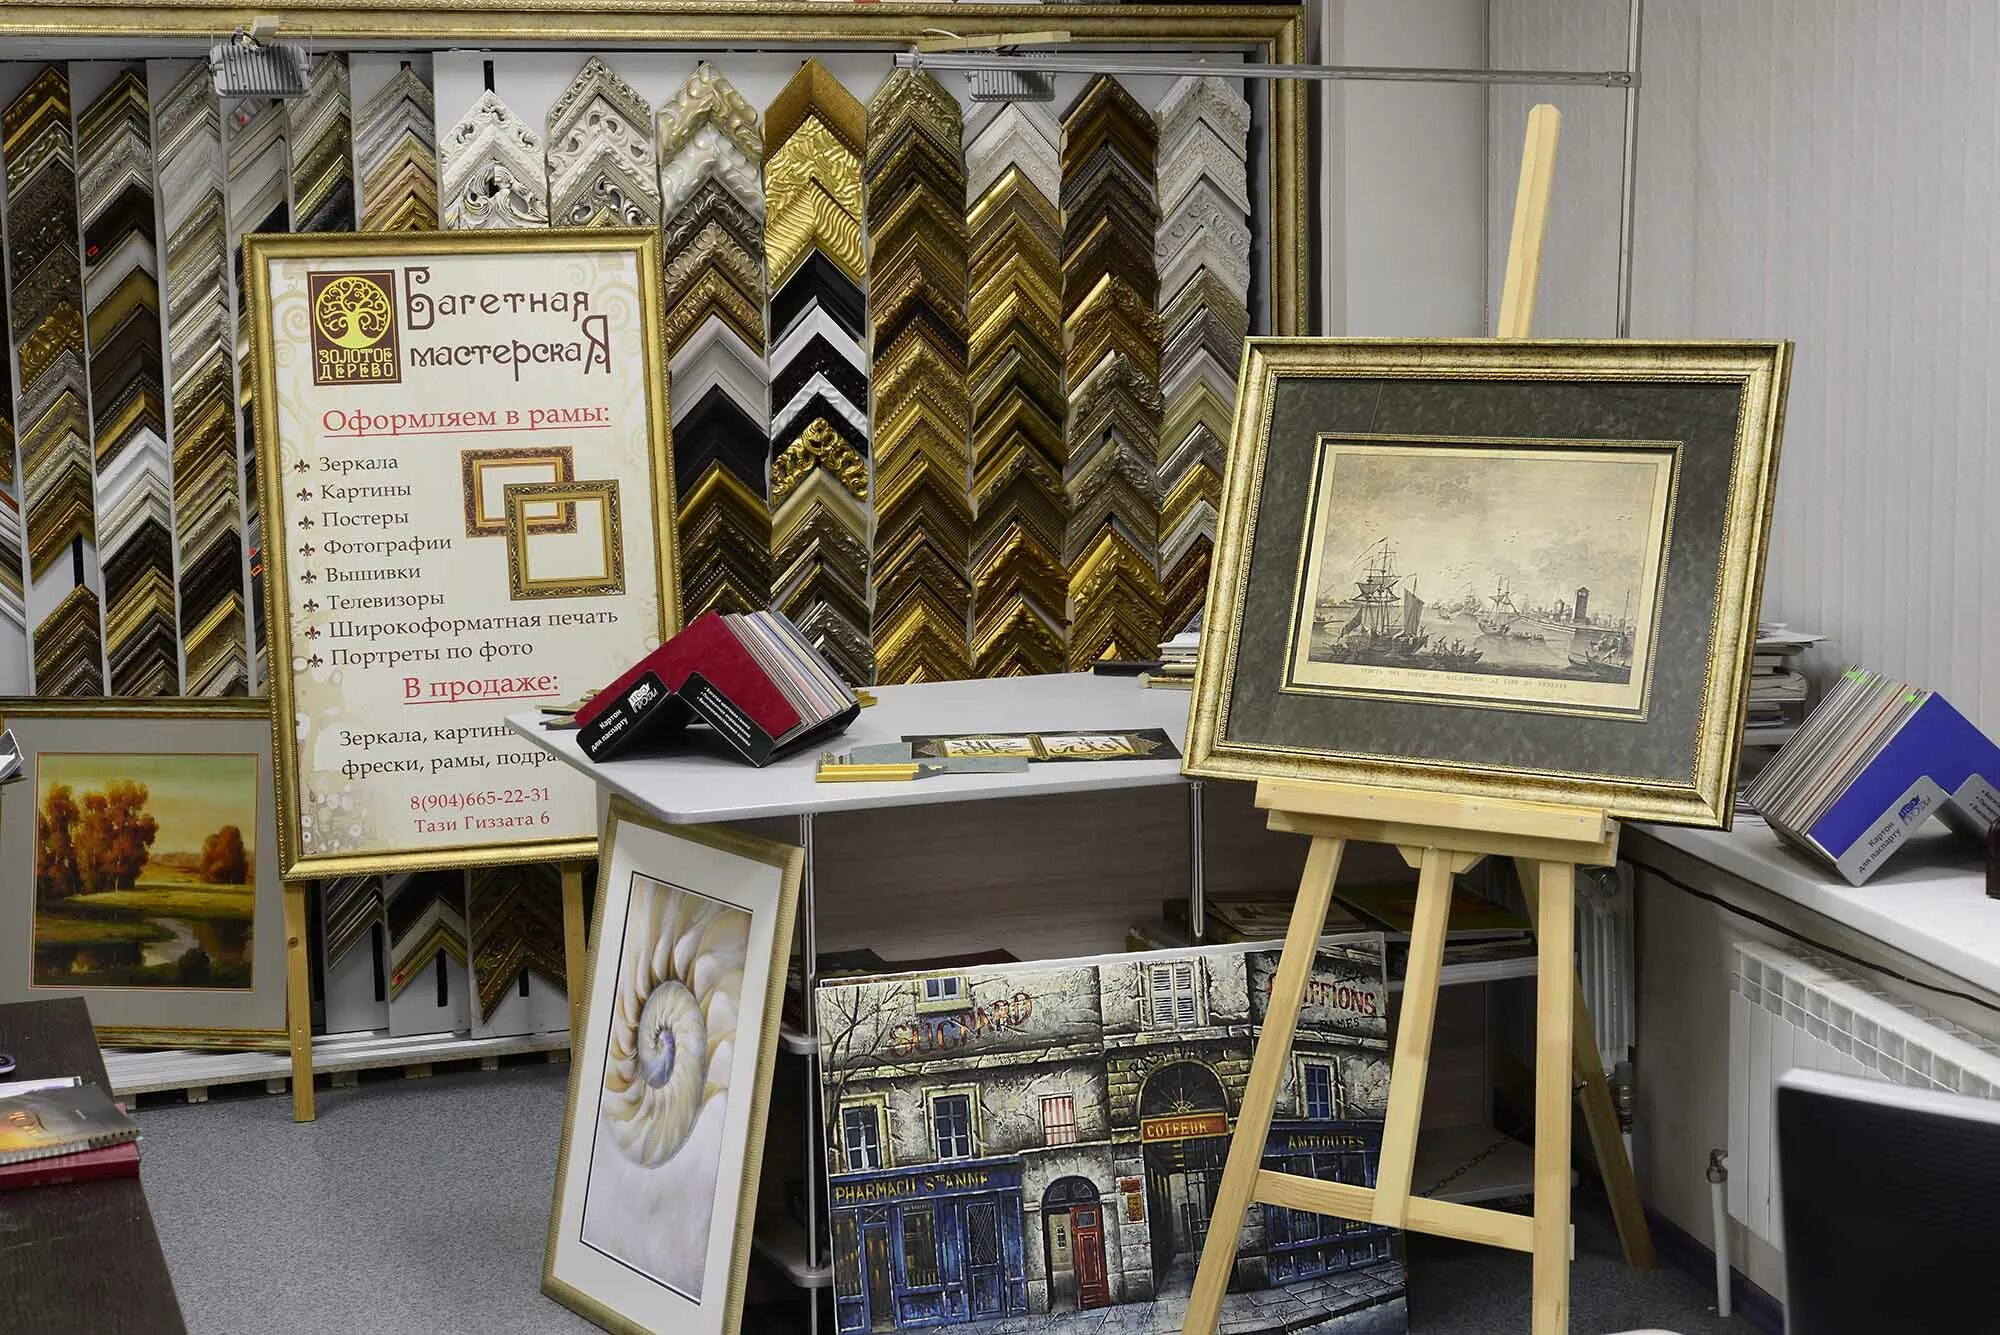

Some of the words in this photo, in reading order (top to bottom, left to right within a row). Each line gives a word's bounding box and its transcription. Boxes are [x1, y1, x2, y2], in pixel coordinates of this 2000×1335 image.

[319, 347, 393, 364] ЗОЛОТОЕ
[319, 362, 393, 381] ДЕРЕВО
[322, 409, 497, 436] Оформляем
[506, 409, 520, 425] в
[529, 406, 610, 431] рамы:
[319, 455, 399, 475] Зеркала
[321, 483, 411, 503] Картины
[322, 511, 409, 531] Постеры
[323, 535, 452, 557] Фотографии
[326, 566, 421, 583] Вышивки
[326, 592, 445, 611] Телевизоры
[329, 616, 541, 641] Широкоформатная
[548, 609, 618, 628] печать
[331, 646, 440, 669] Портреты
[447, 644, 473, 659] по
[479, 641, 533, 662] фото
[403, 677, 421, 698] В
[430, 674, 559, 700] продаже:
[598, 709, 622, 730] Картон
[601, 717, 629, 742] паспарту
[339, 730, 428, 750] Зеркала,
[341, 759, 424, 780] фрески,
[431, 753, 490, 774] рамы,
[410, 787, 550, 813] 8(904)665-22-31
[414, 819, 457, 834] Тази
[464, 814, 533, 830] Гиззата
[540, 810, 550, 825] 6
[1868, 822, 1895, 848] Картон
